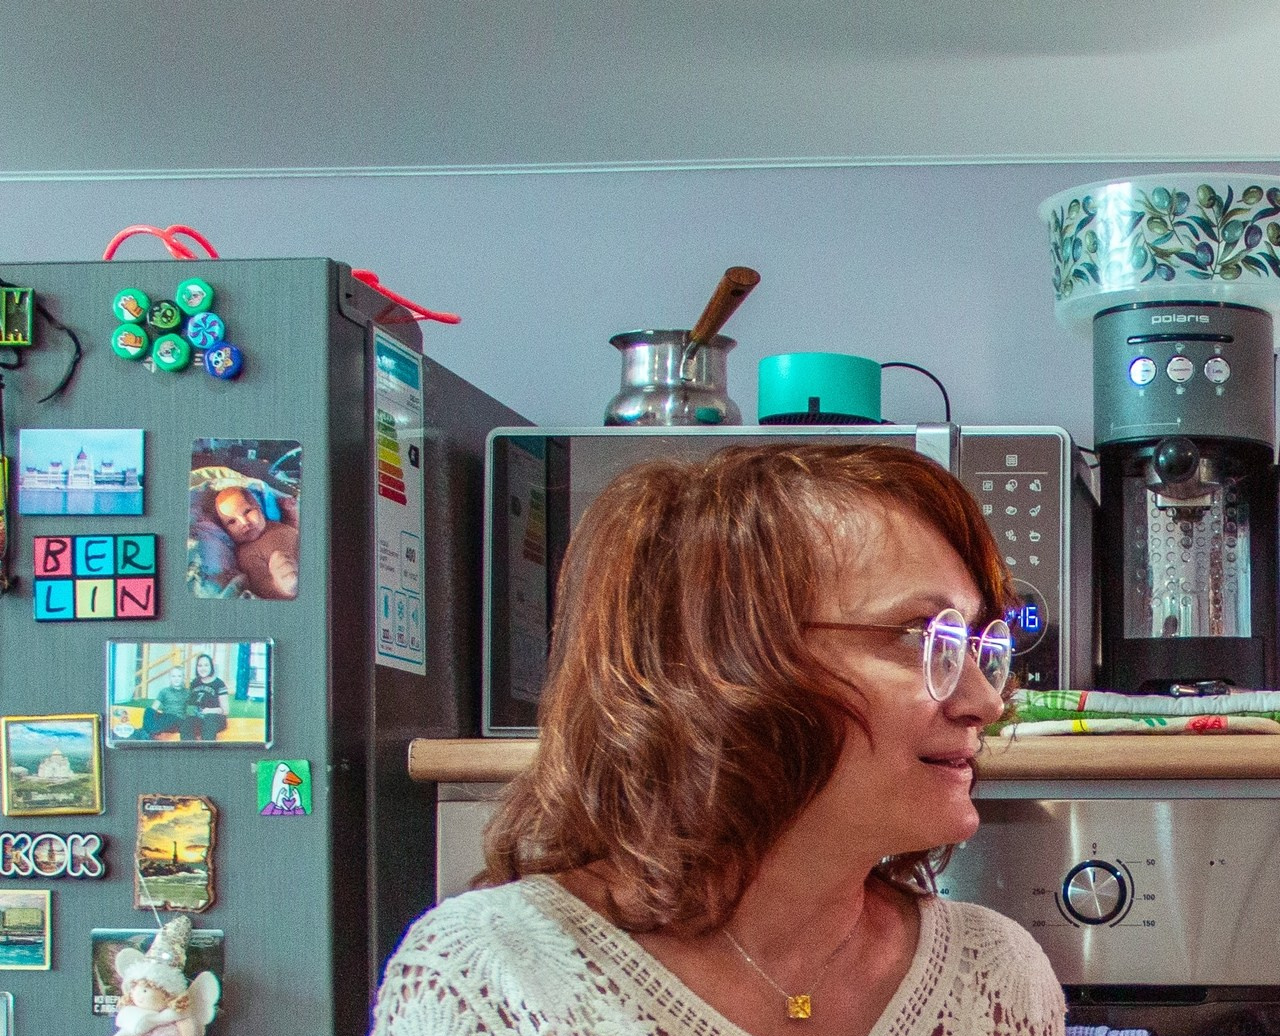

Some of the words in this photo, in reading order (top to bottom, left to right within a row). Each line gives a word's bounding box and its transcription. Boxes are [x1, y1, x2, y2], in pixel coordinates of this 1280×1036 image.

[1151, 314, 1210, 325] polaris
[43, 538, 153, 573] BER
[46, 584, 152, 613] LIN
[1092, 842, 1097, 850] 0
[1143, 893, 1156, 901] 100
[1032, 920, 1046, 928] 200
